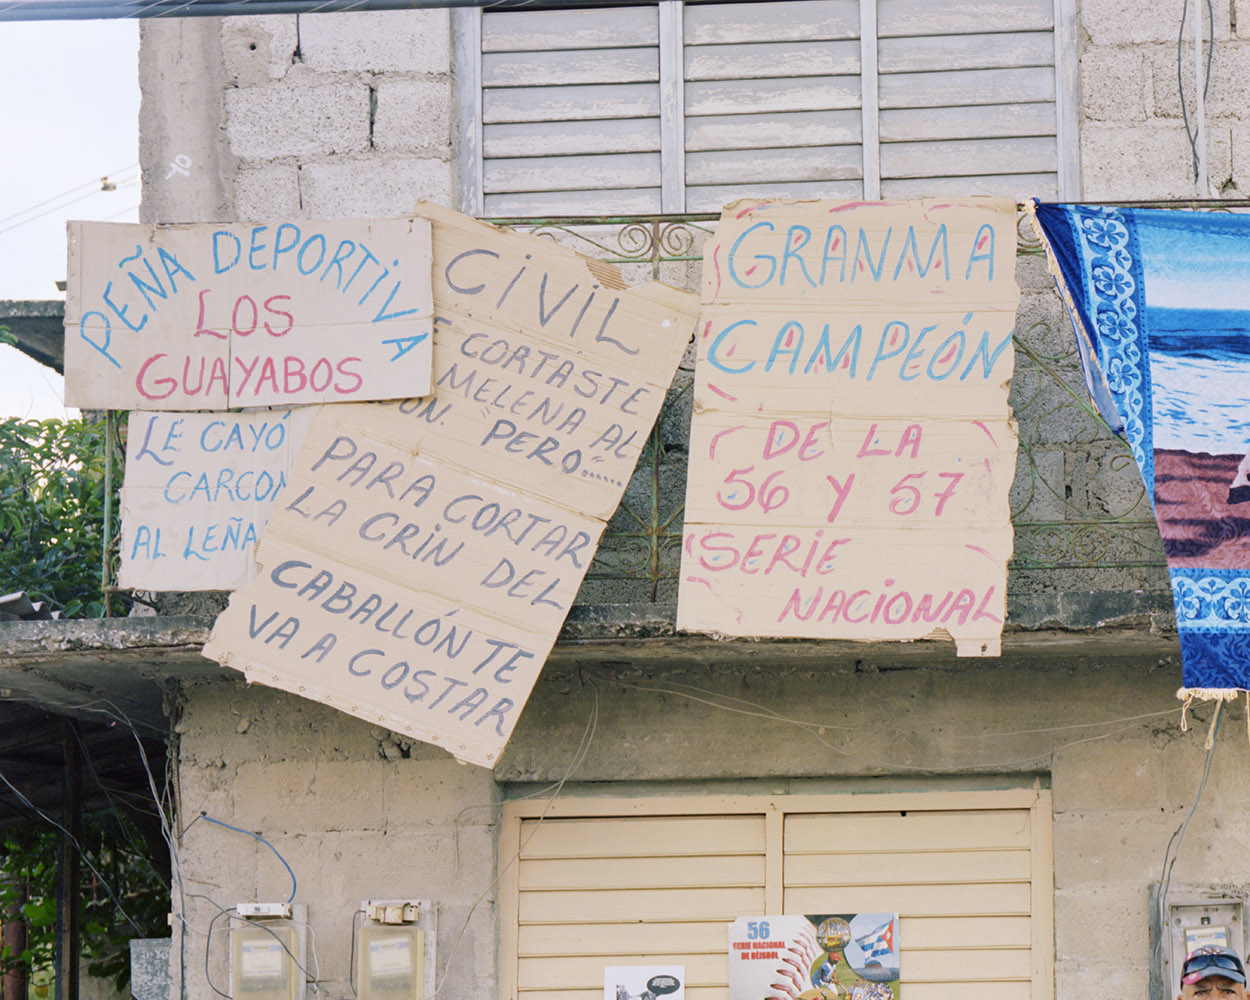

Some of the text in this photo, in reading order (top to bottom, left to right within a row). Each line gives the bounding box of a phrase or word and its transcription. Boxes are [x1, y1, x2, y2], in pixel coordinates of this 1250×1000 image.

[728, 222, 995, 289] GRANMA
[80, 223, 429, 369] PEÑA DEPORTIVA
[193, 289, 294, 339] LOS
[445, 249, 640, 355] CIVIL
[135, 353, 363, 400] GUAYABOS
[460, 333, 650, 415] CORTASTE
[707, 312, 1014, 381] CAMPEÓN
[135, 409, 292, 466] LE CAYÓ
[437, 363, 639, 459] MELENA AL
[763, 421, 923, 461] DE LA
[311, 436, 592, 569] PARA CORTAR
[716, 465, 966, 523] 56 Y 57
[131, 516, 268, 561] AL LEÑA
[285, 486, 565, 611] LA CRIN DEL
[699, 529, 853, 578] SERIE
[270, 560, 535, 684] CABALLÓN TE
[777, 578, 1003, 626] NACIONAL
[249, 604, 515, 737] VA A COSTAR
[741, 951, 750, 960] DE
[747, 921, 770, 939] 56
